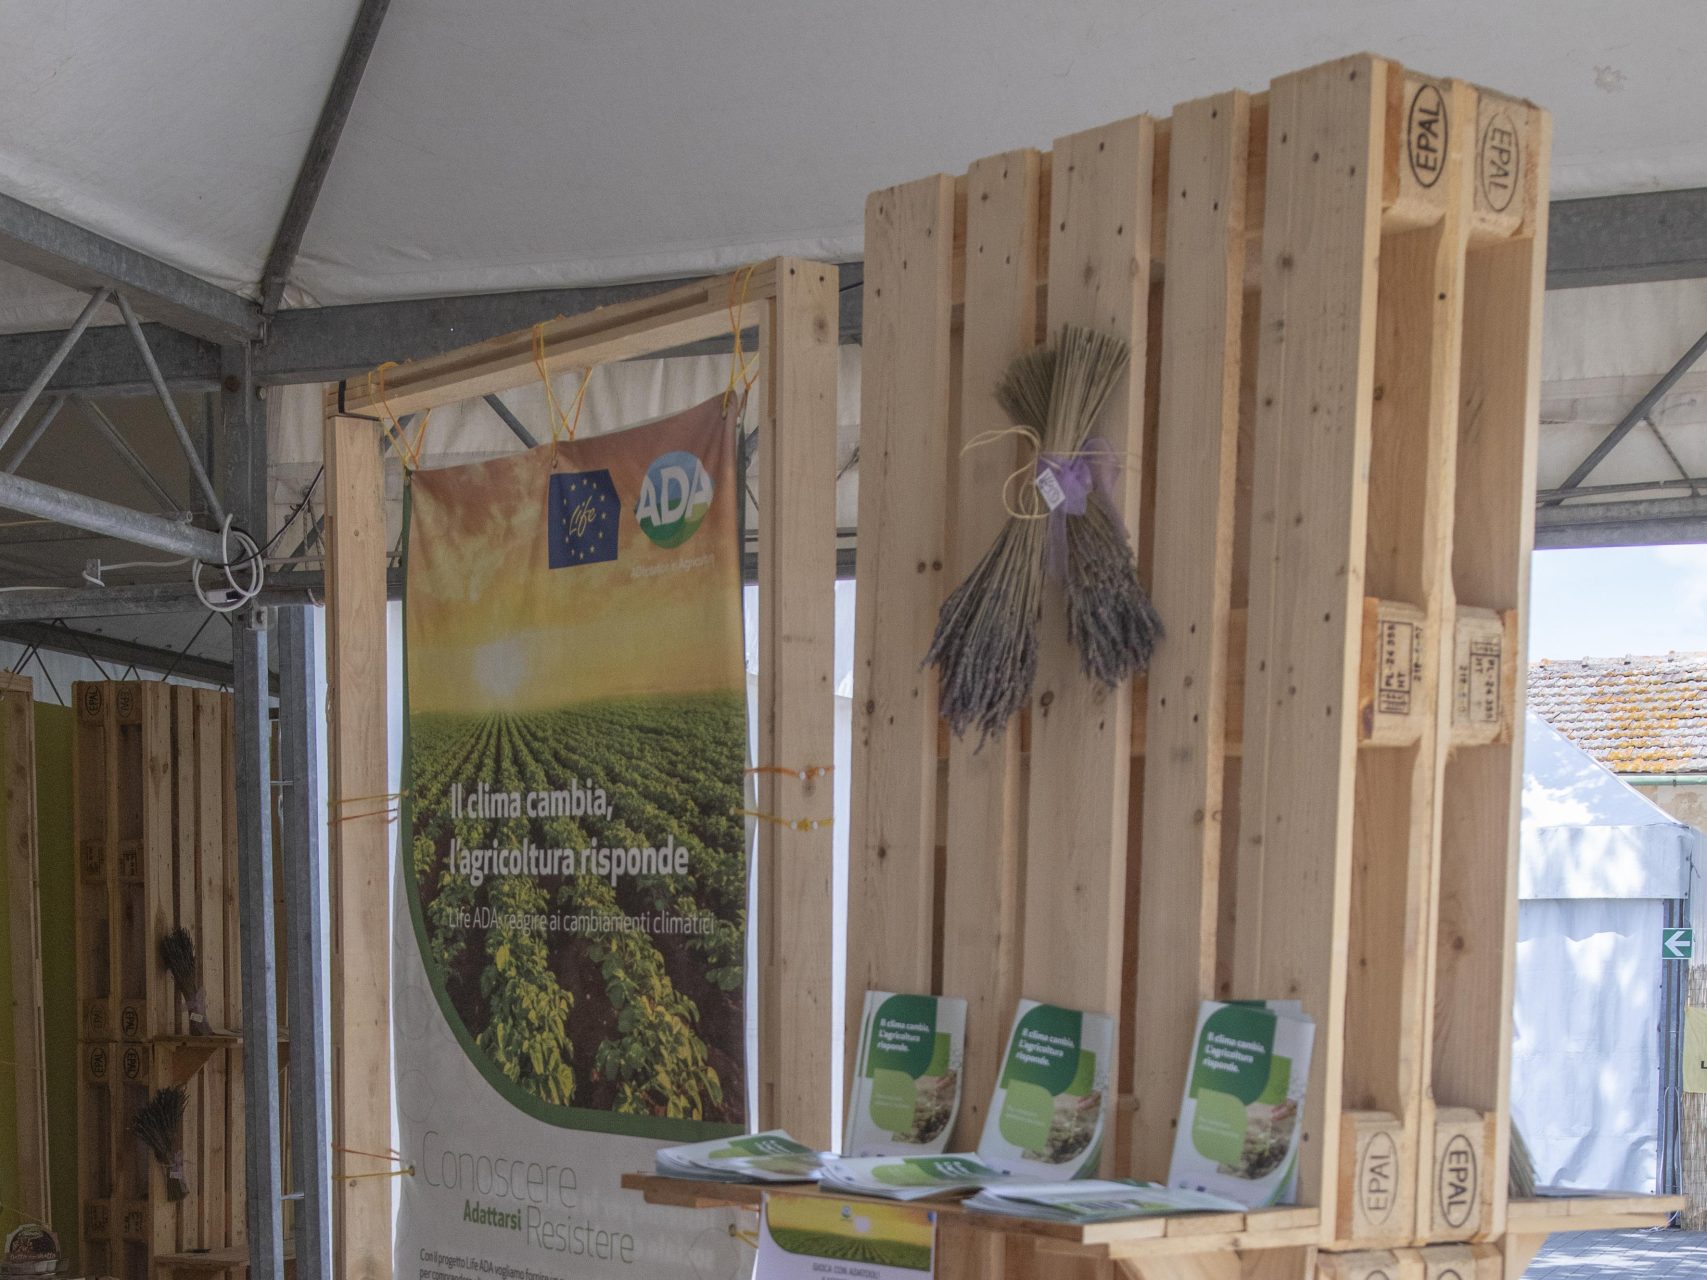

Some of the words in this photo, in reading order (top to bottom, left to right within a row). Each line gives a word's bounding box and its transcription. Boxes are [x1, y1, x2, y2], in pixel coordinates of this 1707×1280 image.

[1415, 100, 1441, 173] EPAL
[1488, 127, 1513, 193] EPAL
[635, 458, 714, 527] ADA
[569, 495, 597, 537] Life
[451, 782, 463, 819] Il
[467, 781, 522, 819] clima
[526, 778, 613, 821] cambia,
[449, 838, 575, 886] l'agricoltura
[580, 834, 689, 887] risponde
[448, 906, 471, 928] Life
[503, 912, 548, 936] reagire
[550, 910, 561, 931] ai
[563, 909, 651, 934] cambiamenti
[653, 911, 715, 935] climatici
[887, 1020, 905, 1030] clima
[1029, 1029, 1049, 1042] clima
[1215, 1033, 1236, 1047] clima
[422, 1130, 577, 1209] Conoscere
[1367, 1144, 1391, 1211] EPAL
[1447, 1150, 1469, 1214] EPAL
[463, 1200, 522, 1231] Adattarsi
[526, 1205, 634, 1264] Resistere
[419, 1268, 431, 1280] per
[420, 1248, 433, 1262] Con
[438, 1253, 465, 1270] progetto
[466, 1257, 479, 1271] Life
[480, 1259, 494, 1274] ADA
[495, 1264, 524, 1280] vogliamo
